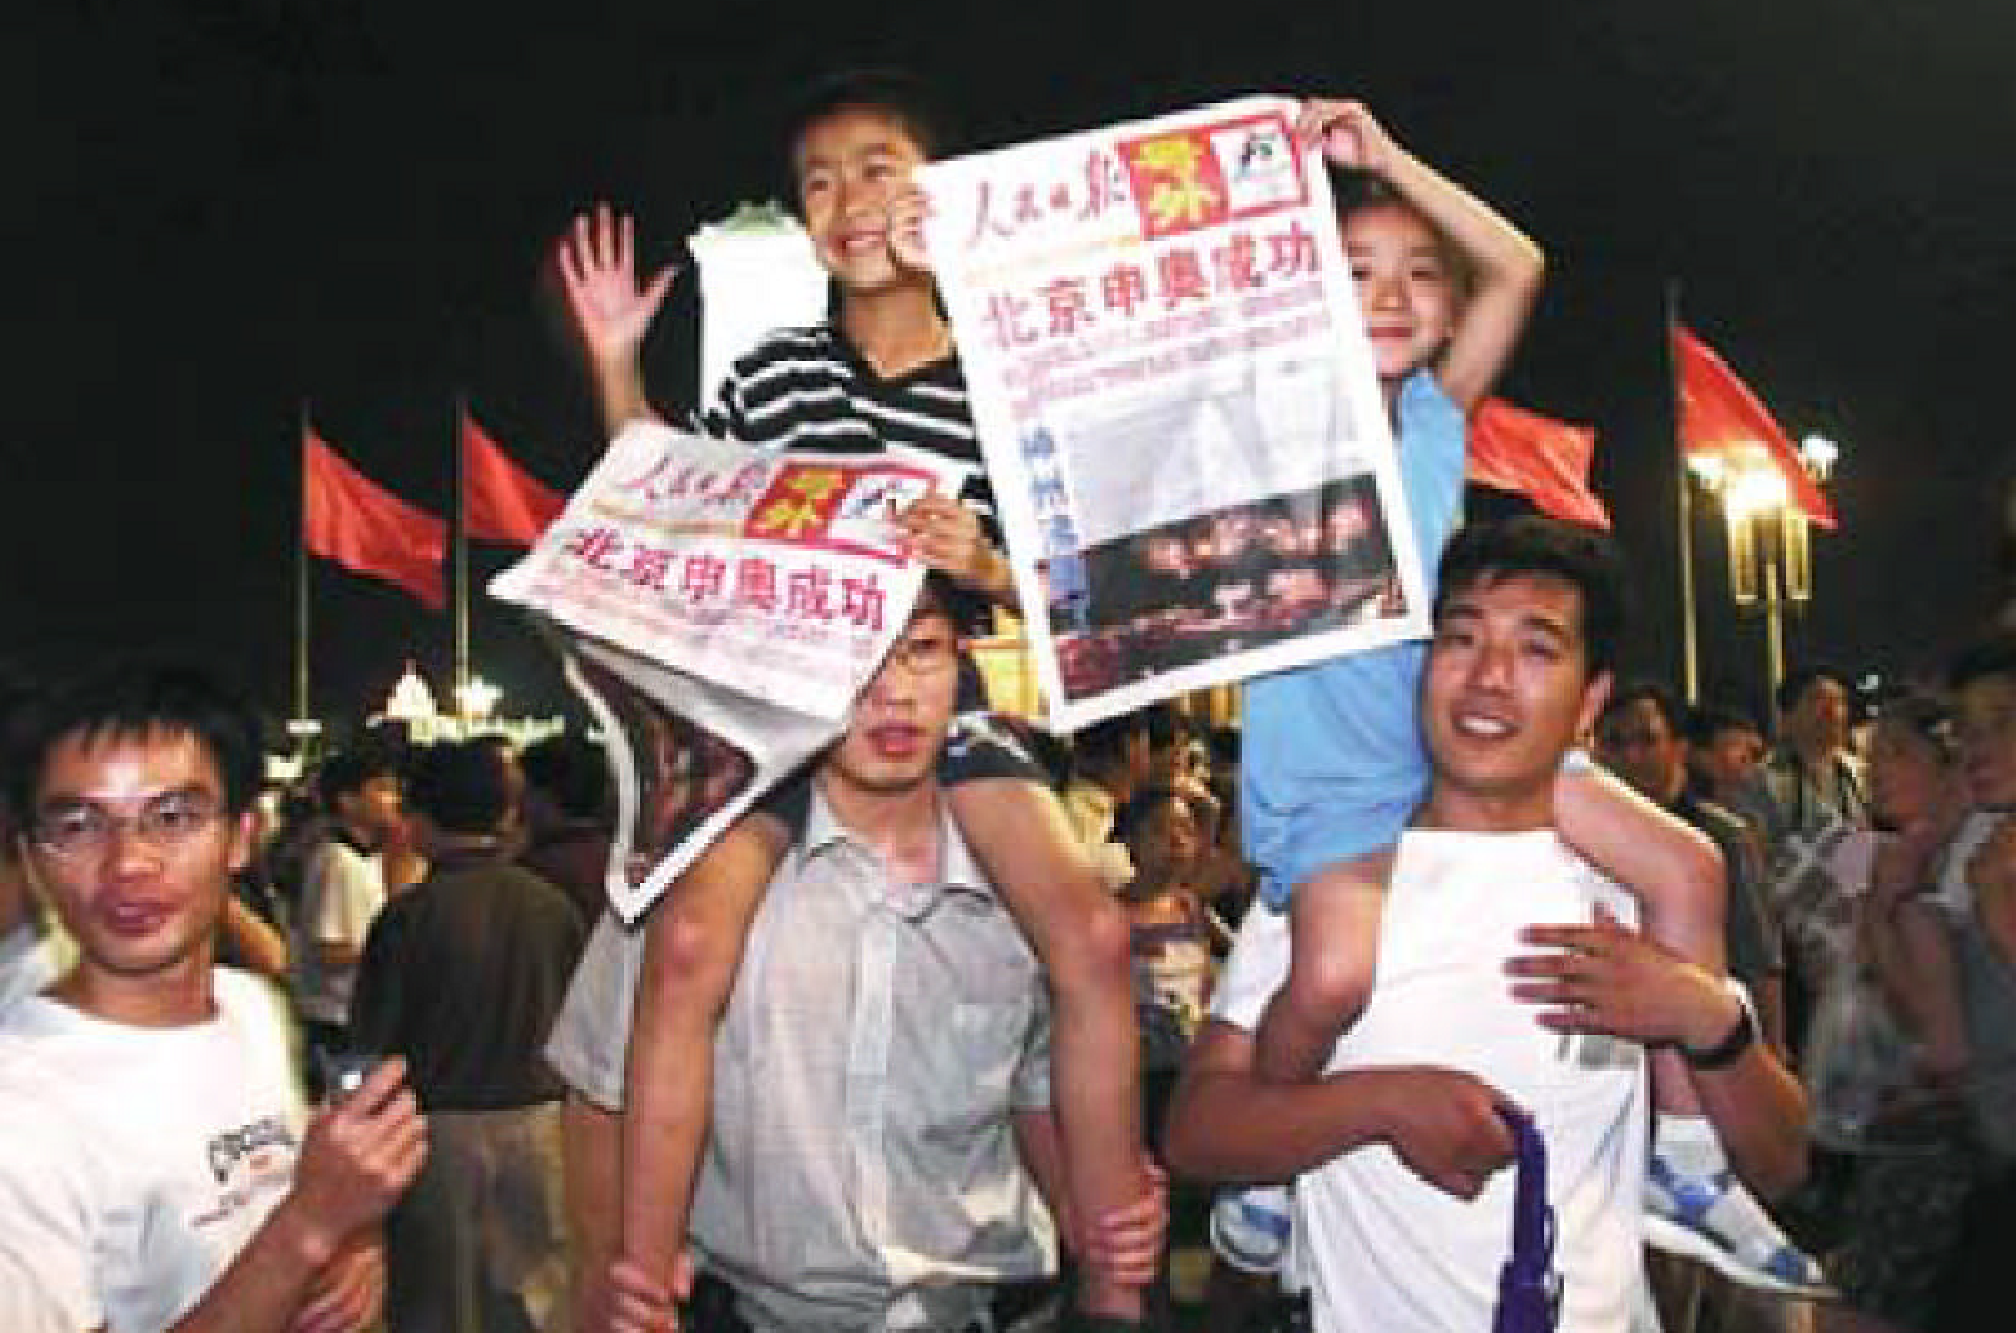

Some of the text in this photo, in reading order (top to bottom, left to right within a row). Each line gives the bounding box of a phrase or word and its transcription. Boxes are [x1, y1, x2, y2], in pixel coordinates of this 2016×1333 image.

[981, 221, 1320, 350] 北京申奥成功
[564, 527, 887, 631] 北京申奥成功
